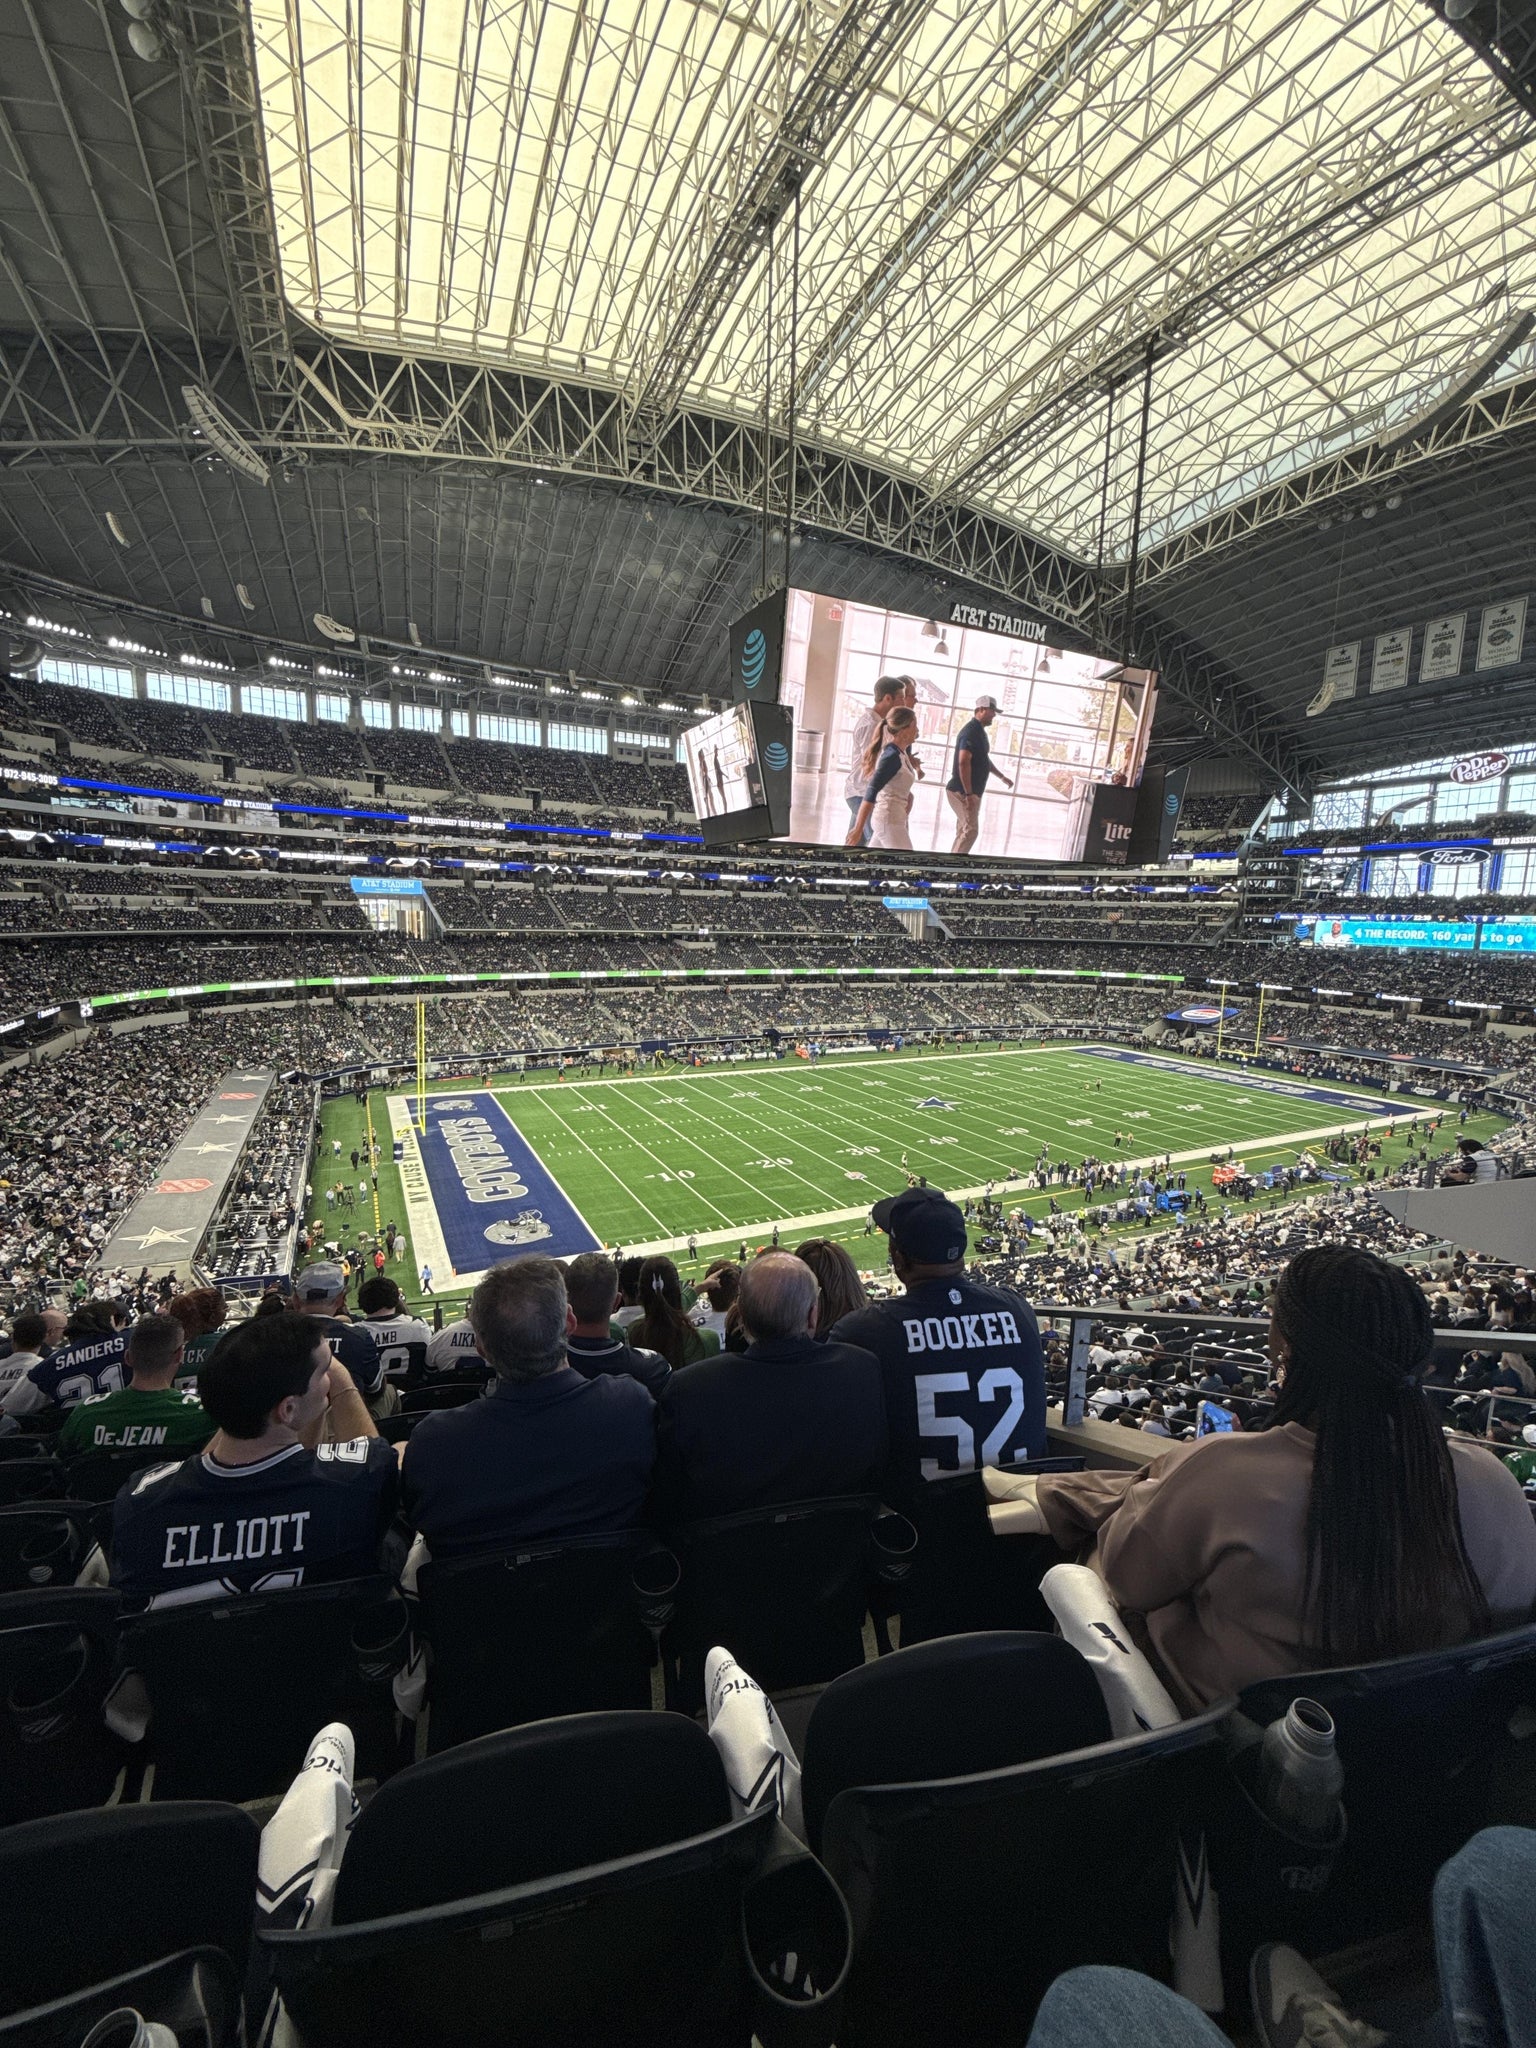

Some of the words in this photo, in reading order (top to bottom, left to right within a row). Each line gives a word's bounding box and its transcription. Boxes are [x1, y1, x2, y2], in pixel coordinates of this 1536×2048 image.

[950, 604, 987, 628] AT&T
[988, 612, 1047, 641] STADIUM
[1456, 758, 1506, 782] Pepper
[1470, 756, 1492, 770] Dr
[4, 768, 58, 786] 972-945-3005
[1104, 822, 1132, 842] Lite
[1430, 850, 1476, 864] Ford
[382, 880, 414, 888] STADIUM
[1364, 929, 1382, 938] THE
[1385, 930, 1428, 940] RECORD:
[1432, 931, 1452, 940] 160
[1454, 932, 1487, 944] yars
[1490, 933, 1504, 942] to
[1506, 934, 1523, 946] go
[438, 1116, 529, 1203] COWBOYS
[846, 1146, 880, 1156] 30
[756, 1157, 794, 1168] 20
[403, 1163, 424, 1188] CAUSE
[654, 1170, 696, 1182] 10
[408, 1190, 429, 1204] MY
[375, 1330, 397, 1346] AMB
[903, 1310, 1022, 1353] BOOKER
[56, 1337, 125, 1371] SANDERS
[181, 1348, 206, 1365] ICK
[0, 1368, 24, 1380] AMB
[56, 1362, 126, 1409] 21
[914, 1367, 1028, 1482] 52
[162, 1511, 311, 1569] ELLIOTT
